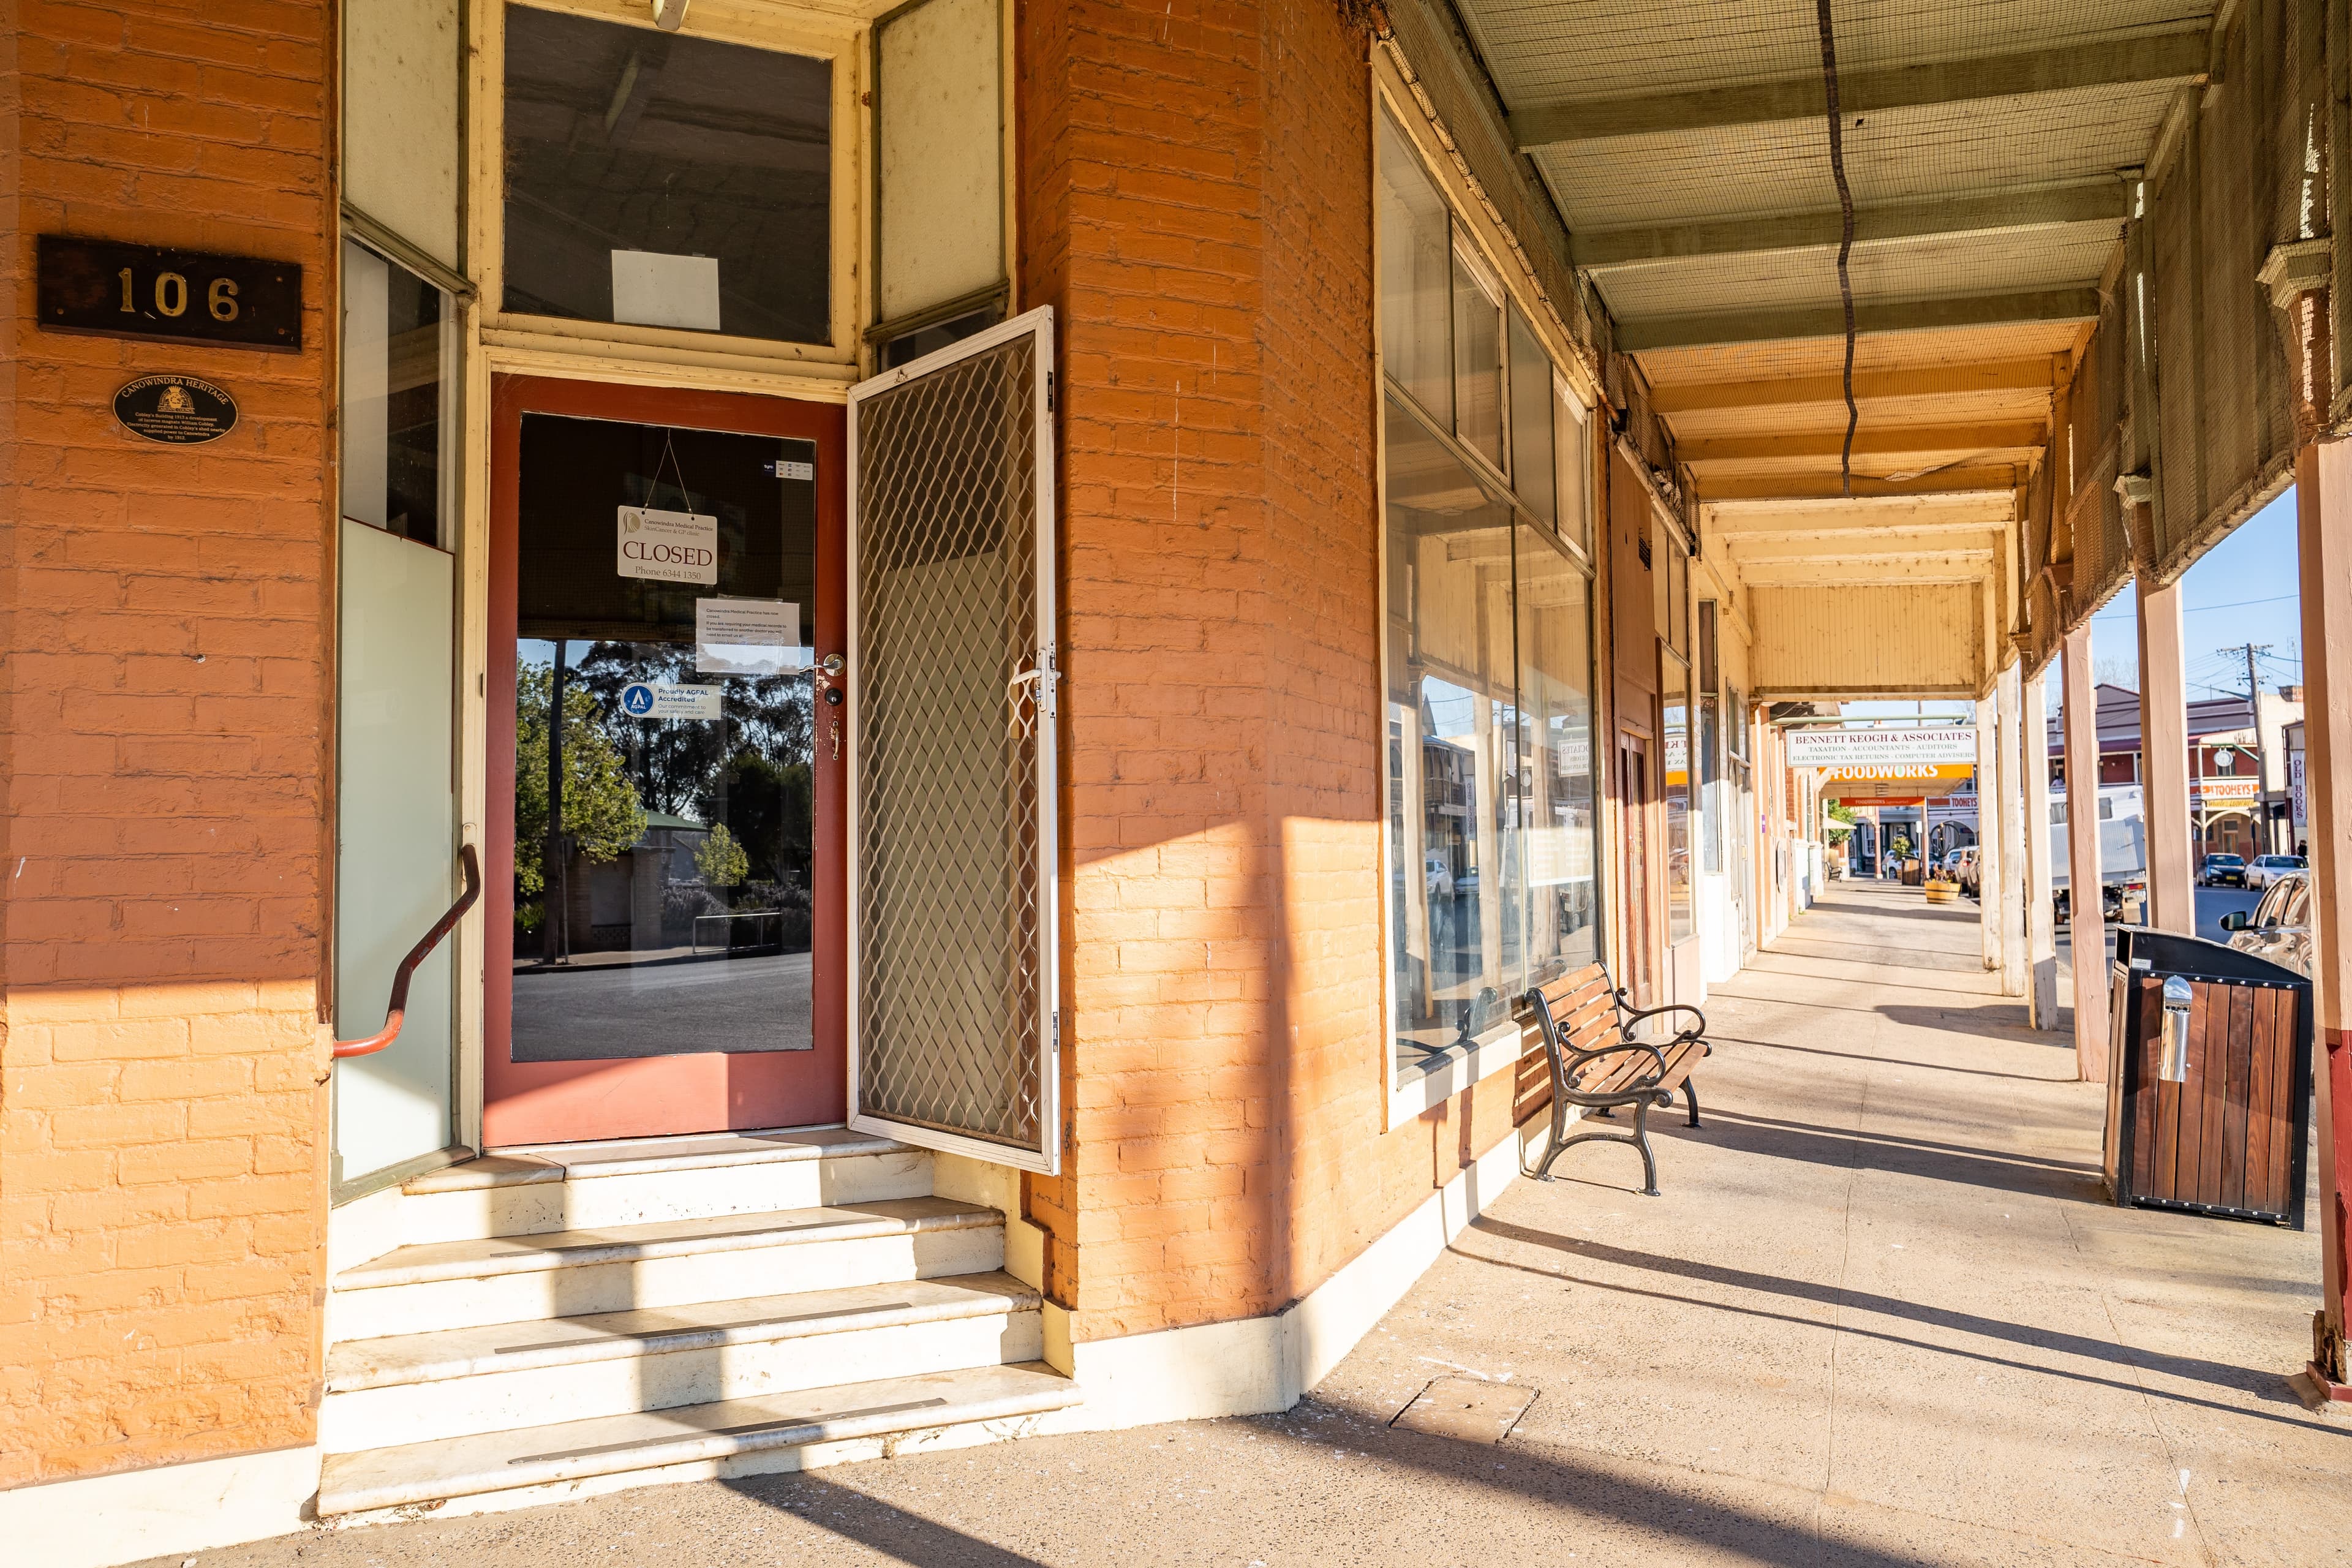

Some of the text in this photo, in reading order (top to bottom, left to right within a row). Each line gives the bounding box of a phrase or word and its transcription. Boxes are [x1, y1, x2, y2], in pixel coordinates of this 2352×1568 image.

[118, 267, 239, 322] 106
[122, 377, 183, 398] CANOWINDRA
[186, 379, 228, 405] HERITAGE
[623, 541, 713, 566] CLOSED
[635, 566, 701, 580] Phone 6344 1350
[1795, 735, 1847, 744] BENNETT
[1850, 734, 1888, 743] KEOGH
[1901, 733, 1972, 742] ASSOCIATES
[1834, 764, 1938, 779] FOODWORKS
[2215, 784, 2251, 796] TOOHEYS
[1951, 797, 1977, 807] TOOHEYS
